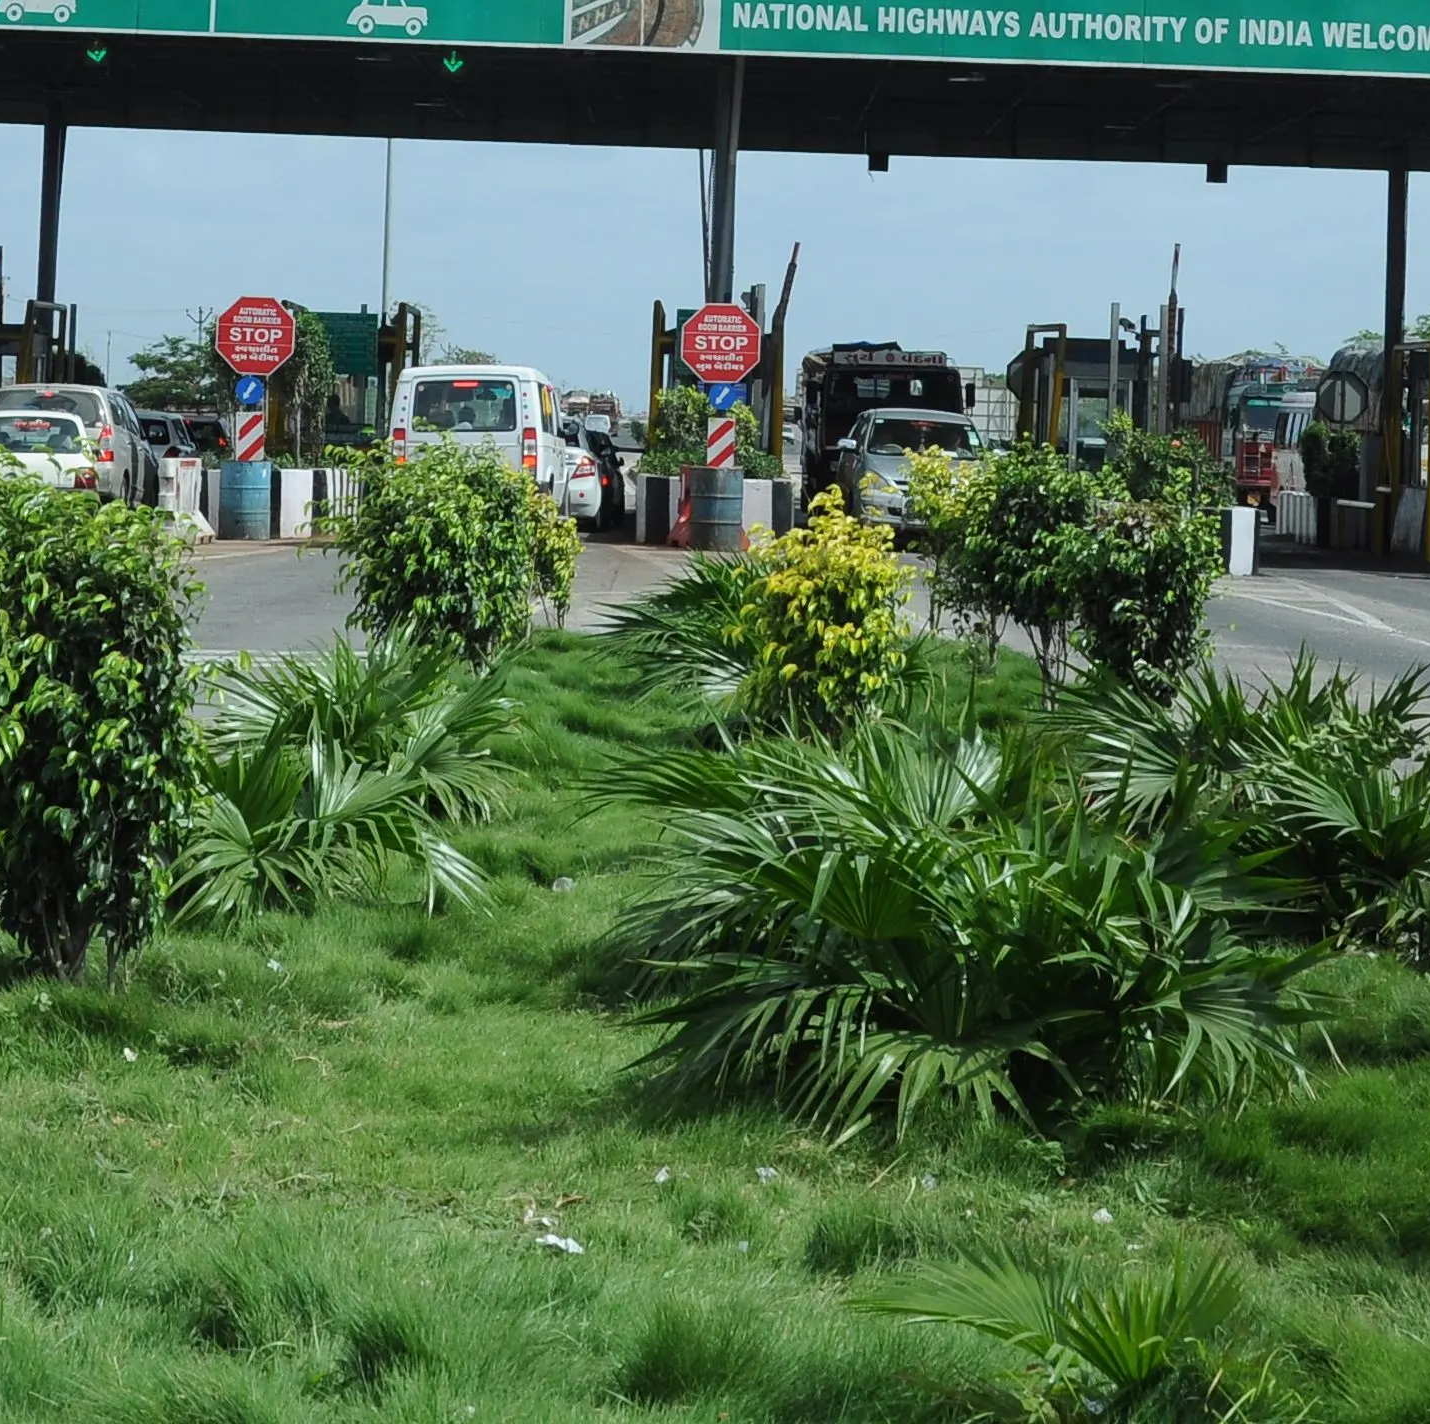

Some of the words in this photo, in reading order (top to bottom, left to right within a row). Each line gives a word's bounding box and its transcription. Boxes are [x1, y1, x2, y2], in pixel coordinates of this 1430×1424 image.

[734, 3, 867, 32] NATIONAL
[879, 8, 1019, 36] HIGHWAYS
[1030, 13, 1186, 42] AUTHORITY
[1195, 18, 1228, 44] OF
[1240, 20, 1312, 46] INDIA
[229, 327, 283, 343] STOP
[694, 335, 748, 351] STOP
